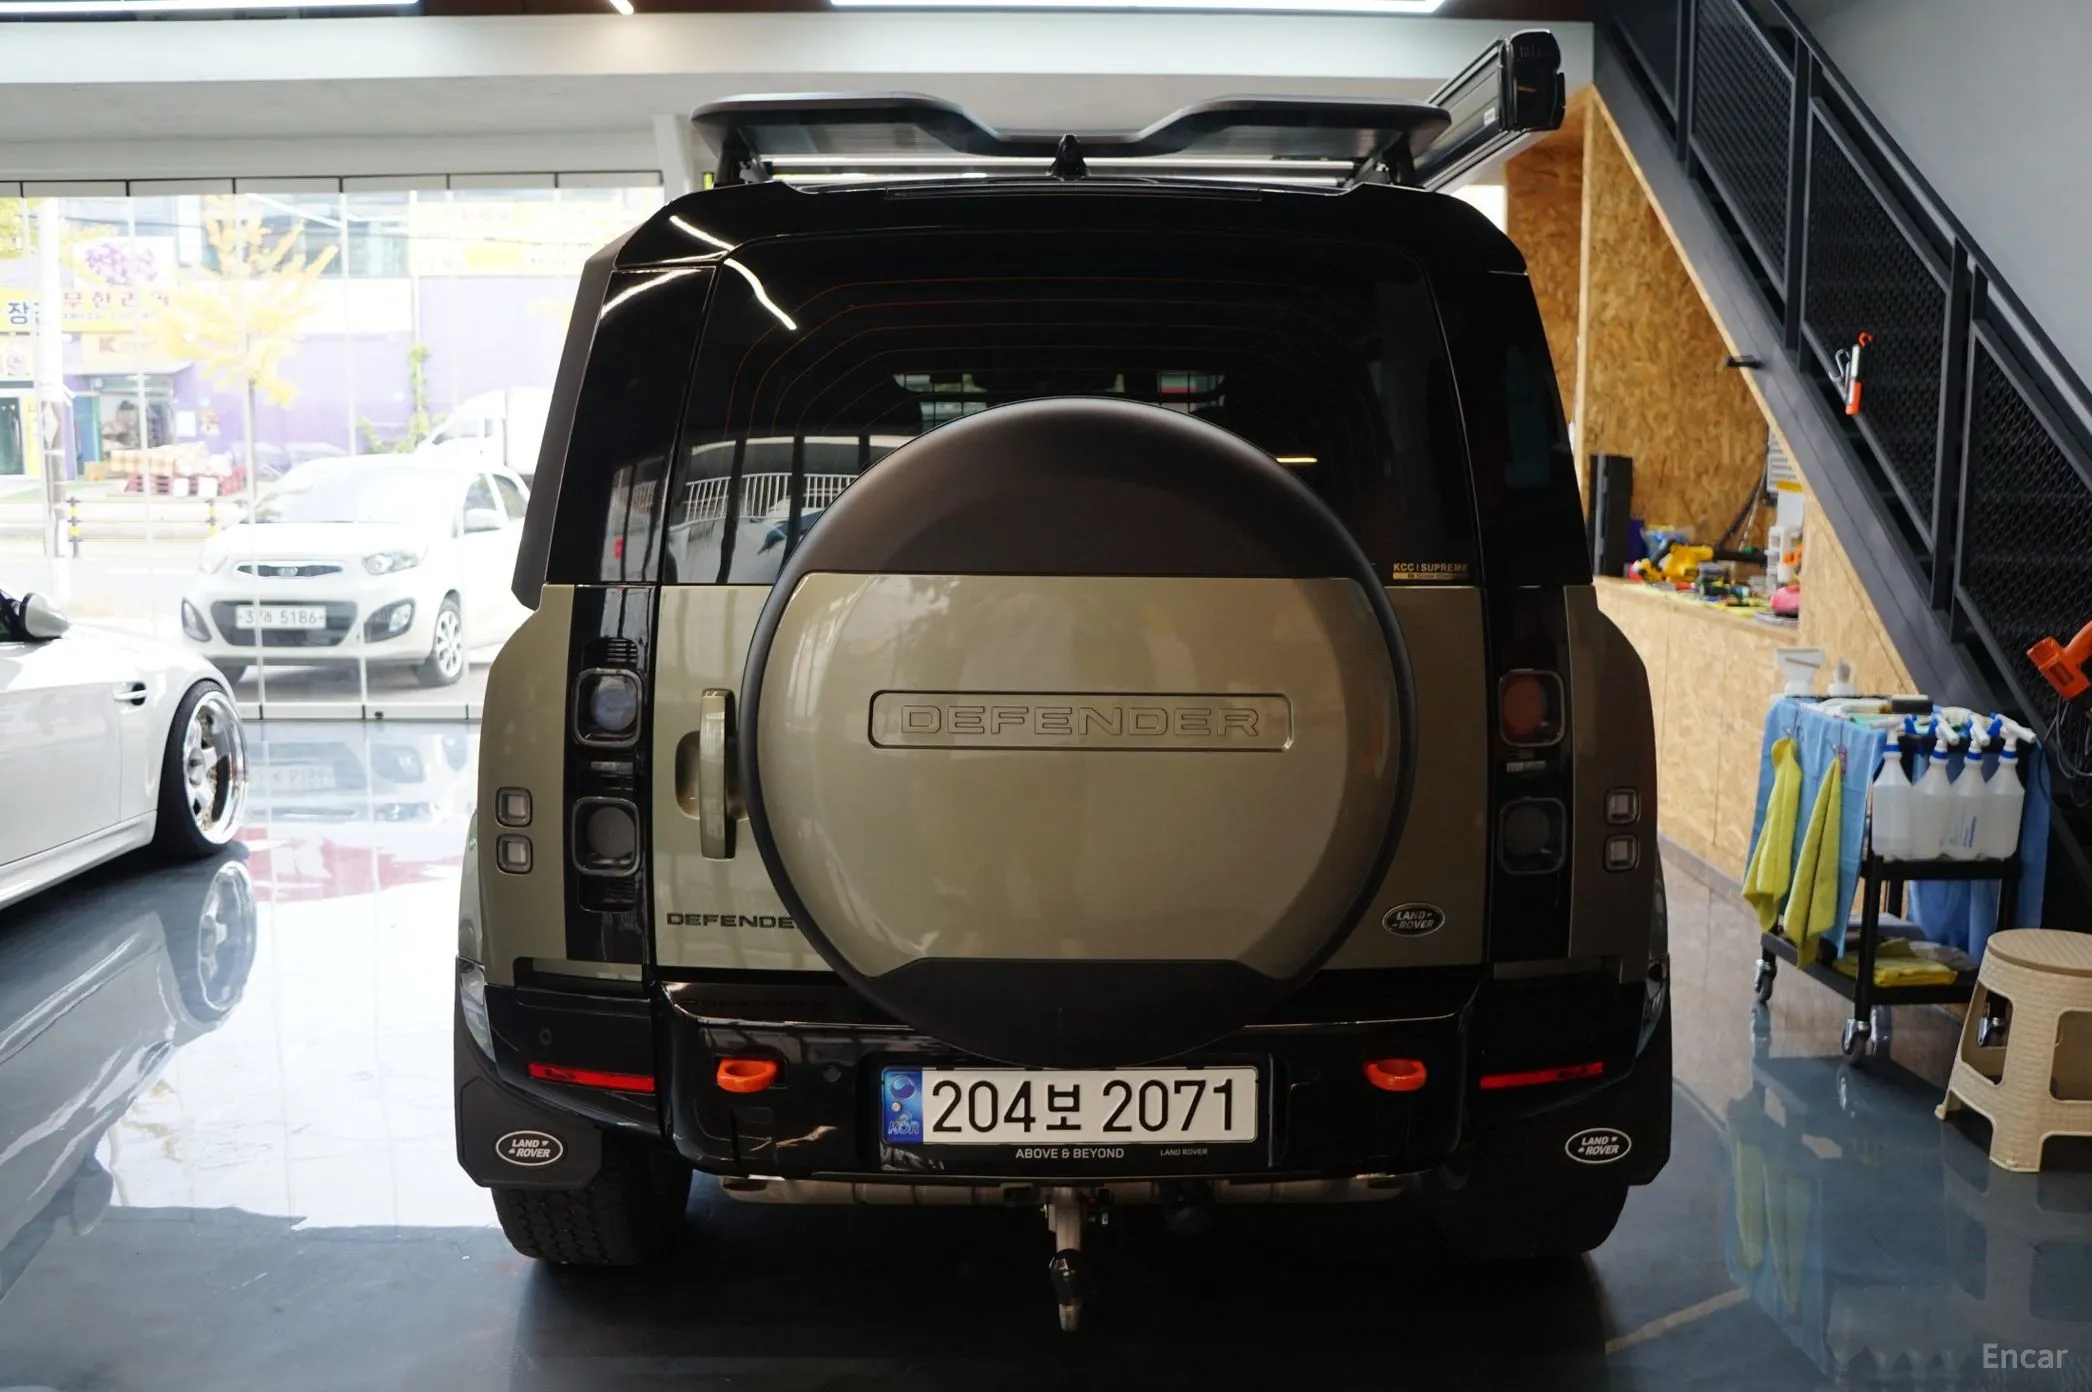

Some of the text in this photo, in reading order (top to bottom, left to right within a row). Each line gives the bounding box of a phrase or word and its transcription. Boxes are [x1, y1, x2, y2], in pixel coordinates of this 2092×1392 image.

[1393, 562, 1468, 573] KCC SUPREME
[280, 610, 317, 624] 5186
[901, 704, 1260, 738] DEFENDER
[666, 913, 797, 929] DEFENDE
[1396, 910, 1426, 921] LAND
[1398, 920, 1435, 929] ROVER
[932, 1079, 1233, 1133] 204보 2071
[887, 1120, 920, 1135] KOR
[511, 1138, 540, 1148] LAND
[1581, 1136, 1609, 1146] LAND
[516, 1148, 551, 1158] ROVER
[1015, 1148, 1125, 1159] ABOVE & BEYOND
[1160, 1148, 1208, 1157] LAND ROVER
[1585, 1144, 1620, 1156] ROVER
